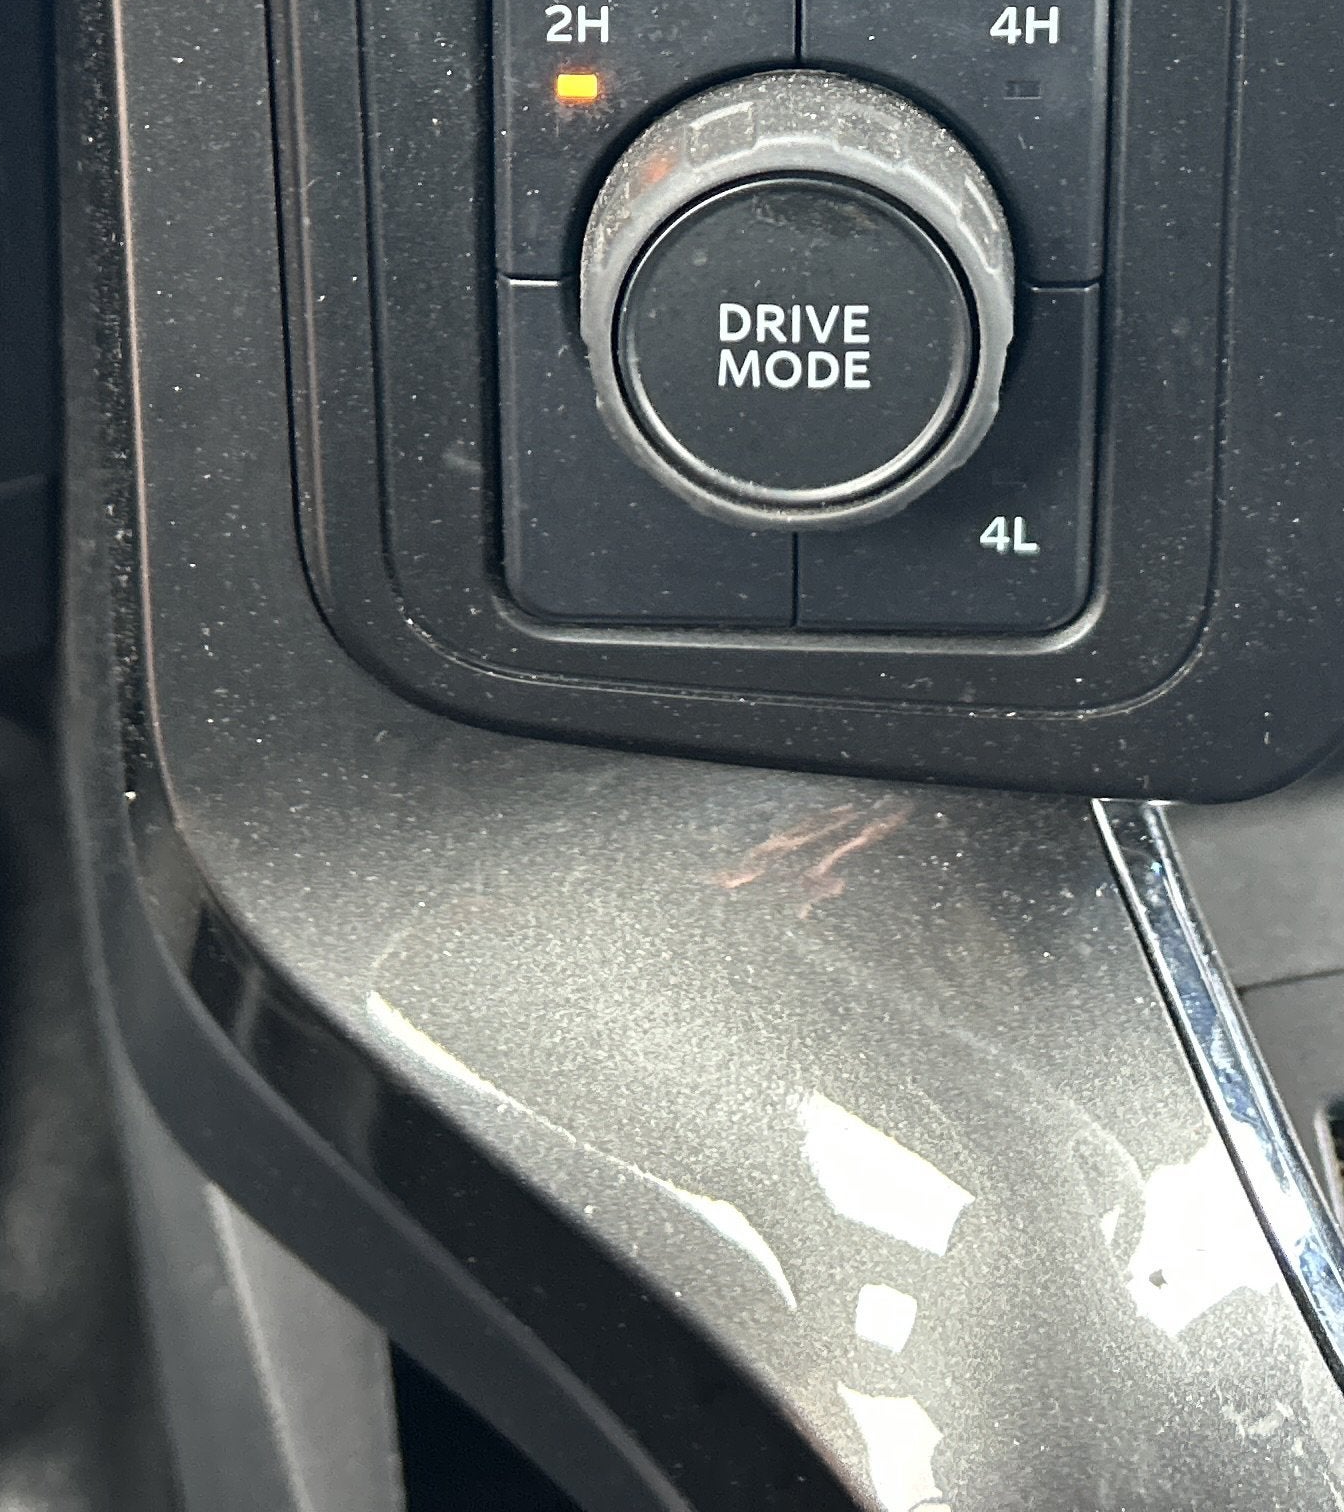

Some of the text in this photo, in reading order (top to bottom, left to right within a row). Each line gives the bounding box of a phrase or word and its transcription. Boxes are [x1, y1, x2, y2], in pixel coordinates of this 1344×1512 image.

[544, 4, 610, 44] 2H
[989, 5, 1060, 45] 4H
[719, 302, 871, 345] DRIVE
[717, 348, 872, 390] MODE
[979, 516, 1041, 555] 4L
